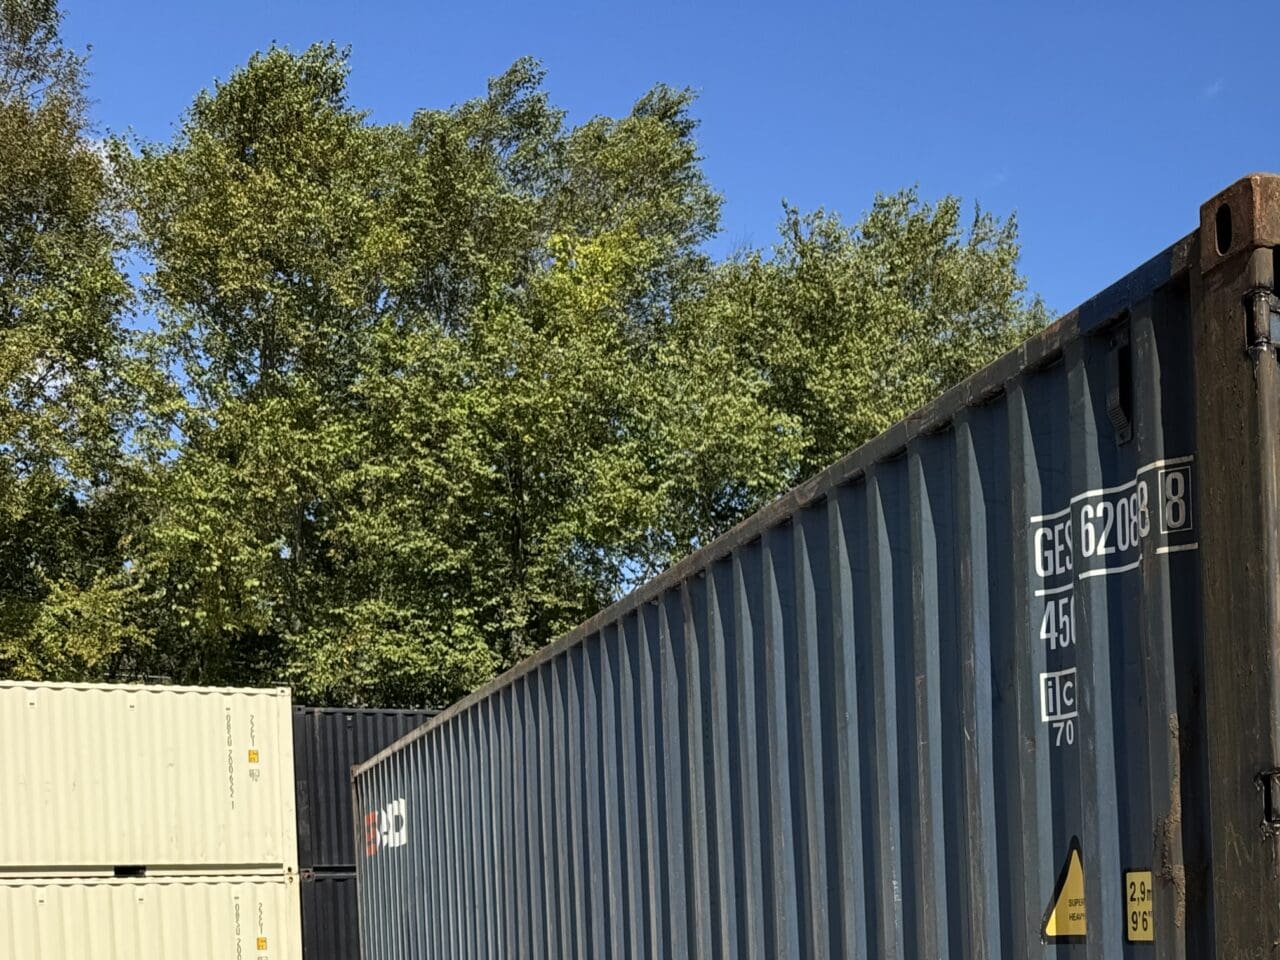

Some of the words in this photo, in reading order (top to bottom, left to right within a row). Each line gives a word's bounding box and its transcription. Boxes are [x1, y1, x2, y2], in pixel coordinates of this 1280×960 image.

[1034, 520, 1074, 578] GES
[1080, 480, 1150, 558] 62088
[1164, 470, 1188, 530] 8
[1053, 720, 1074, 747] 70
